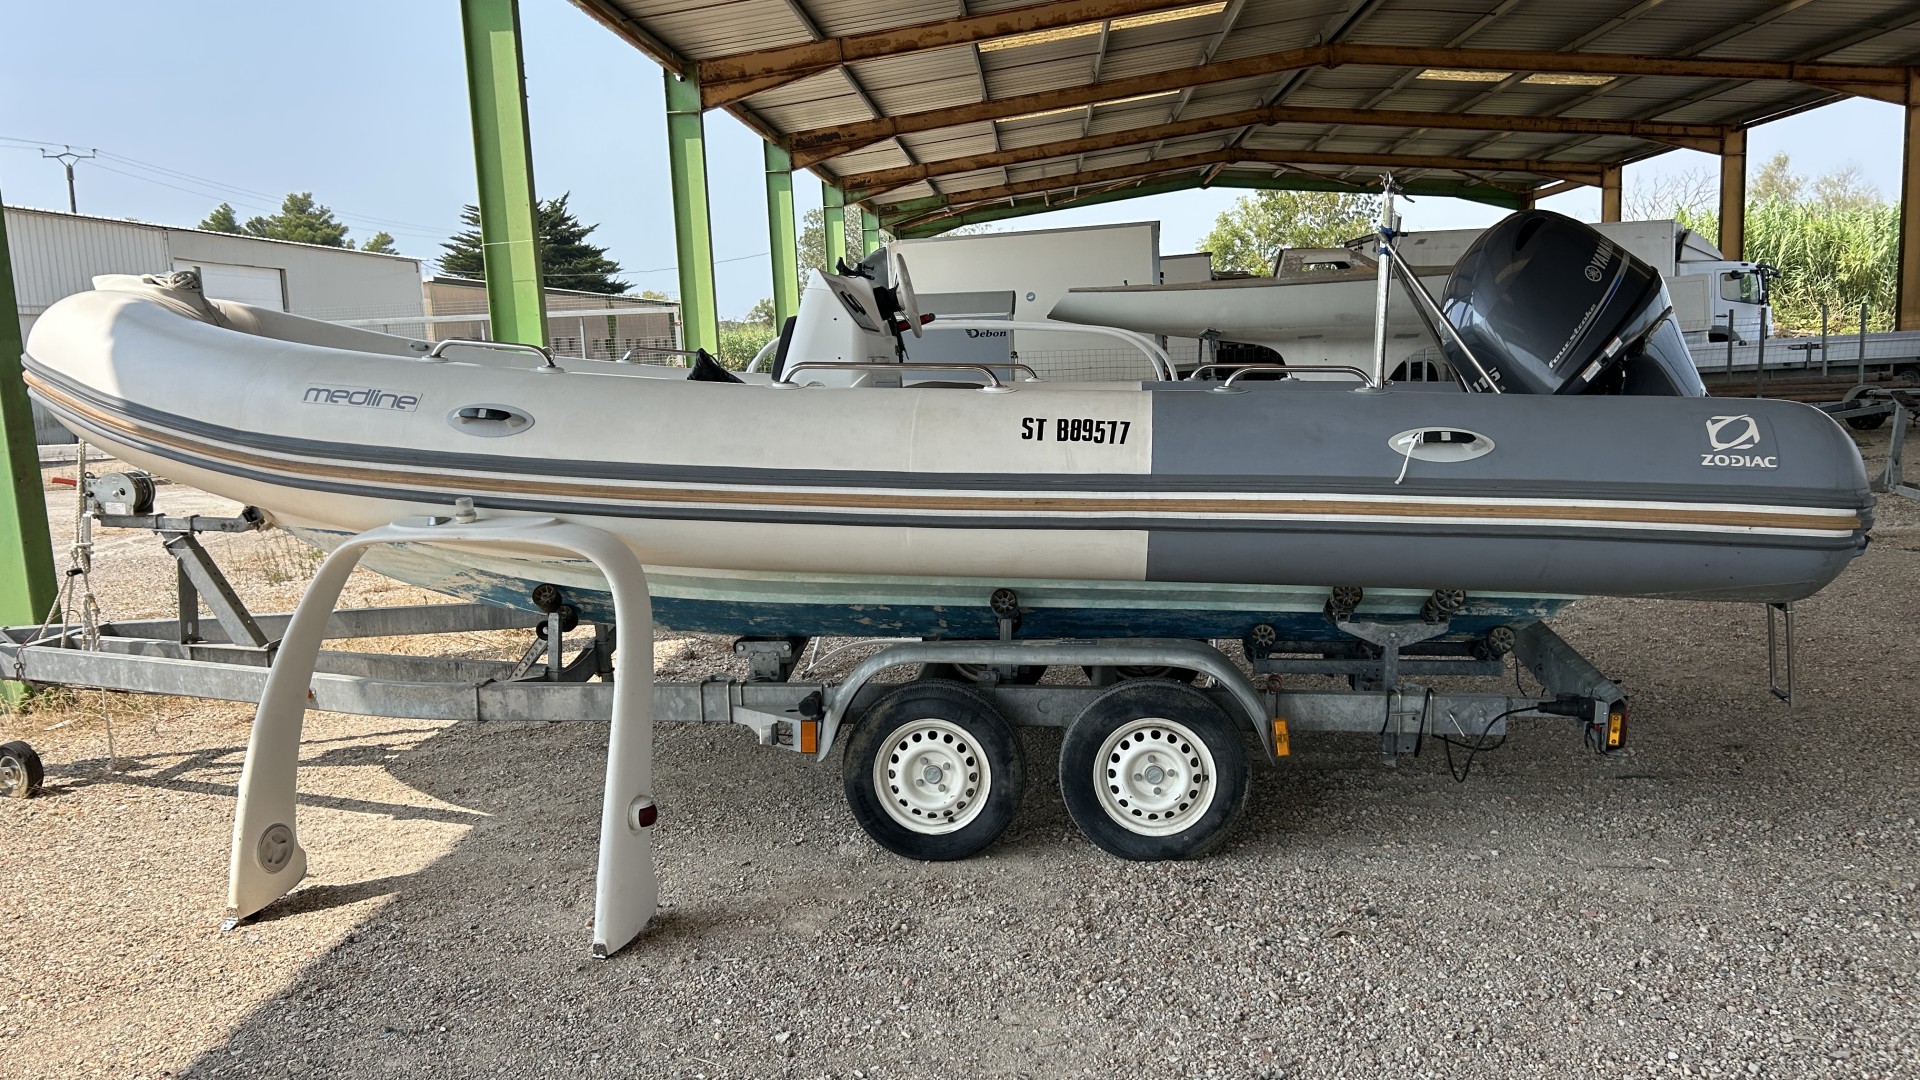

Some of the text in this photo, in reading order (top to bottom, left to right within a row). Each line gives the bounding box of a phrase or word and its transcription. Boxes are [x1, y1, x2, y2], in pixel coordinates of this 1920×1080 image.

[964, 328, 1007, 339] Debon
[302, 388, 418, 410] medline
[1021, 417, 1047, 441] ST
[1700, 454, 1778, 468] ZODIAC
